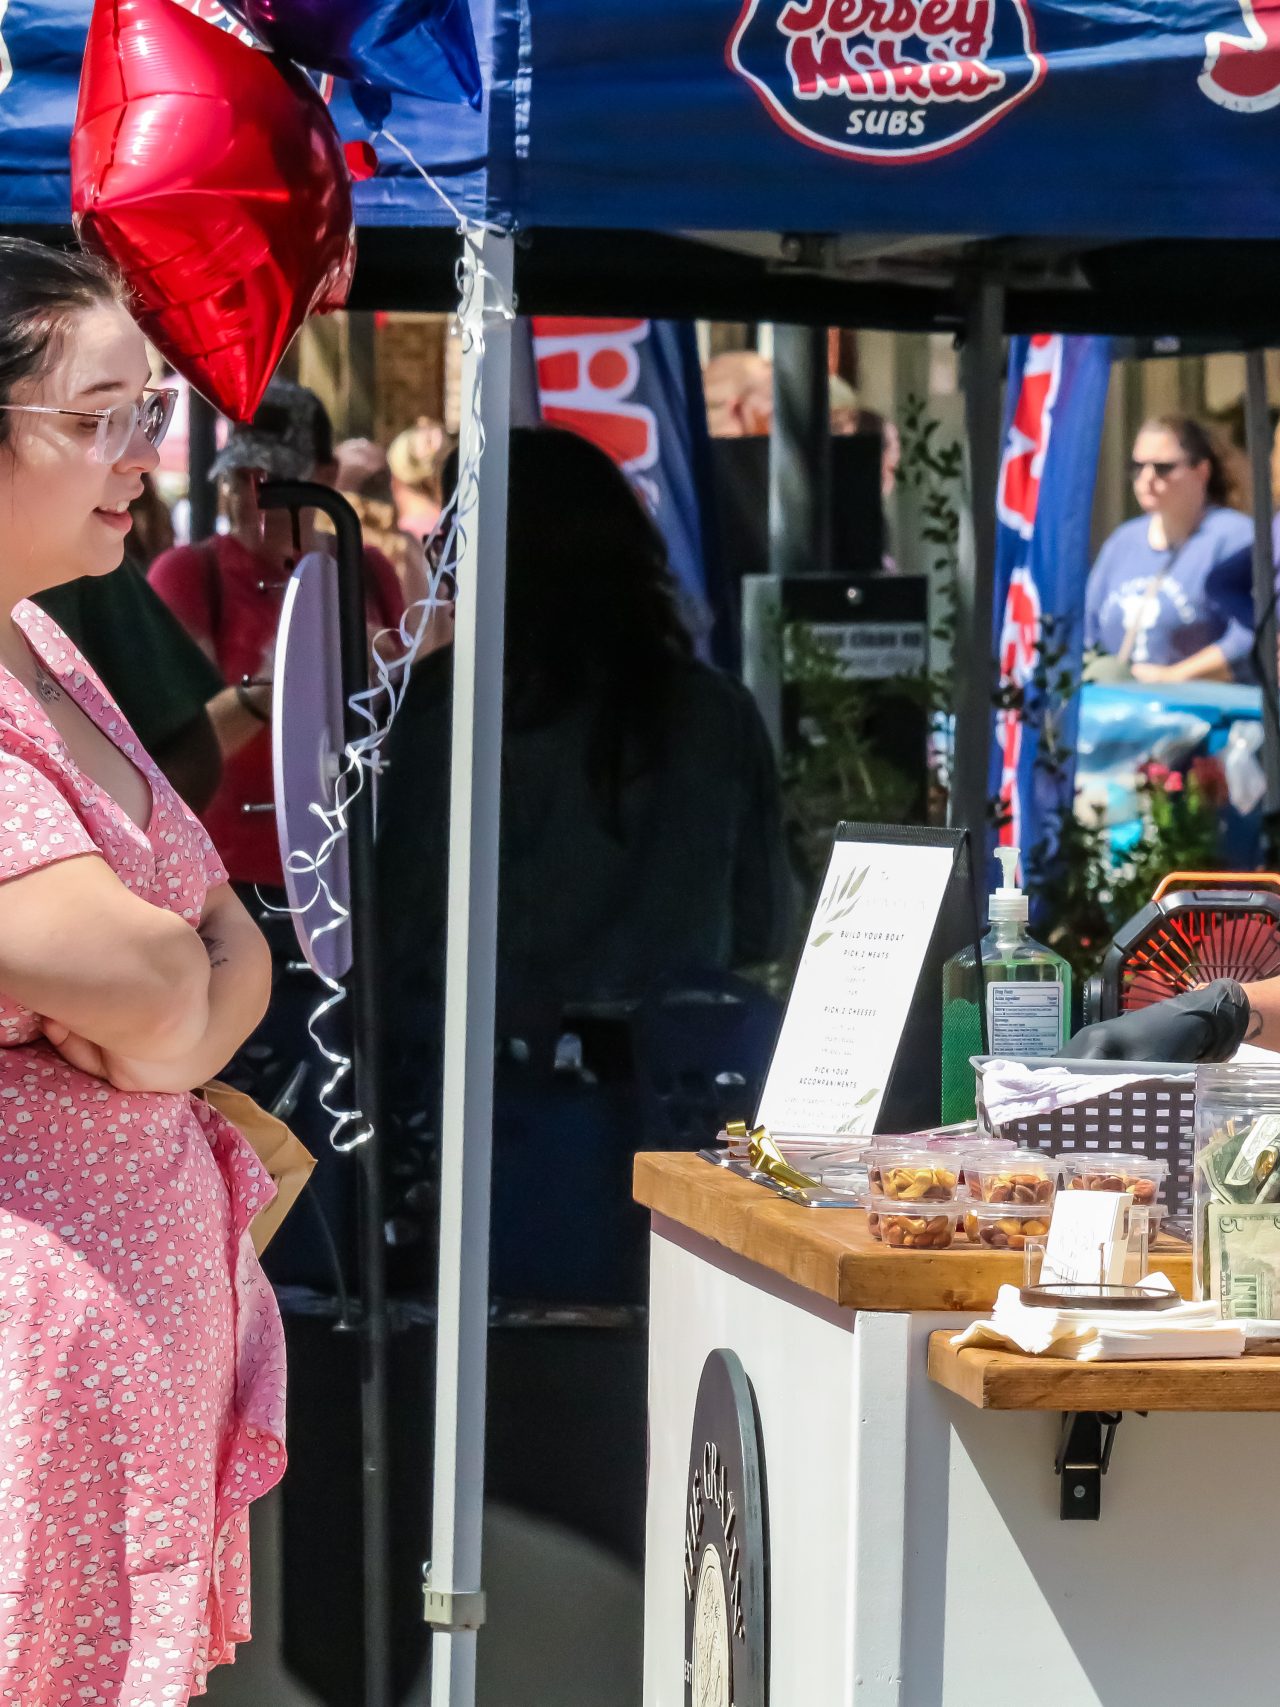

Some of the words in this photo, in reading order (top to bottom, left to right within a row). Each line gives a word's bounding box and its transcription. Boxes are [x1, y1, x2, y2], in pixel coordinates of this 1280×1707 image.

[777, 0, 993, 60] Jersey
[846, 109, 927, 136] SUBS
[840, 930, 861, 939] BUILD
[864, 931, 882, 940] YOUR
